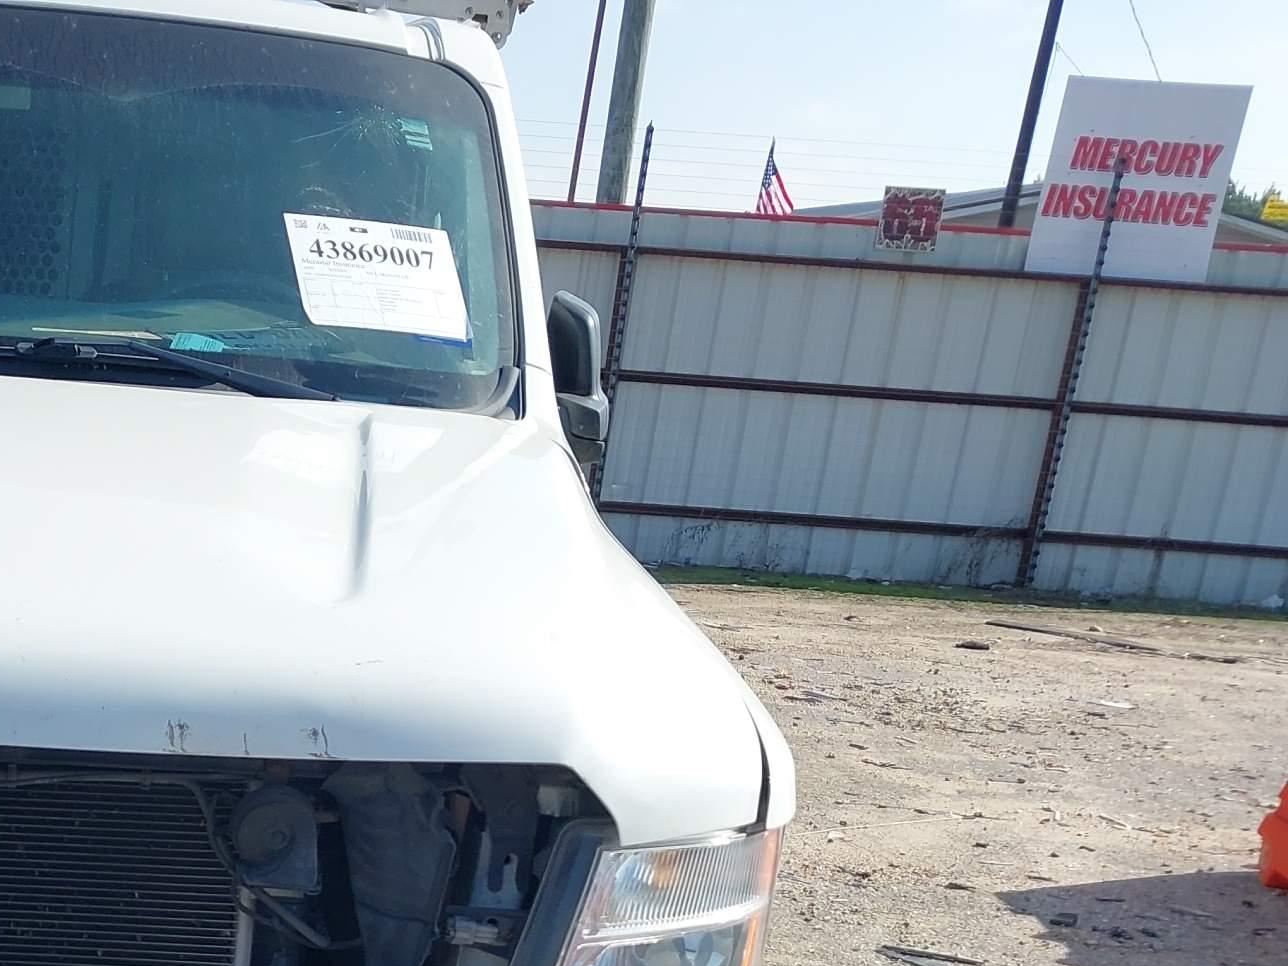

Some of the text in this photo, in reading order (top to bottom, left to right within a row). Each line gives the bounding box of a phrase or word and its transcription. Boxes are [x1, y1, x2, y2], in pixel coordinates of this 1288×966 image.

[1069, 135, 1224, 178] MERCURY
[1041, 183, 1217, 227] INSURANCE
[309, 238, 433, 270] 43869007
